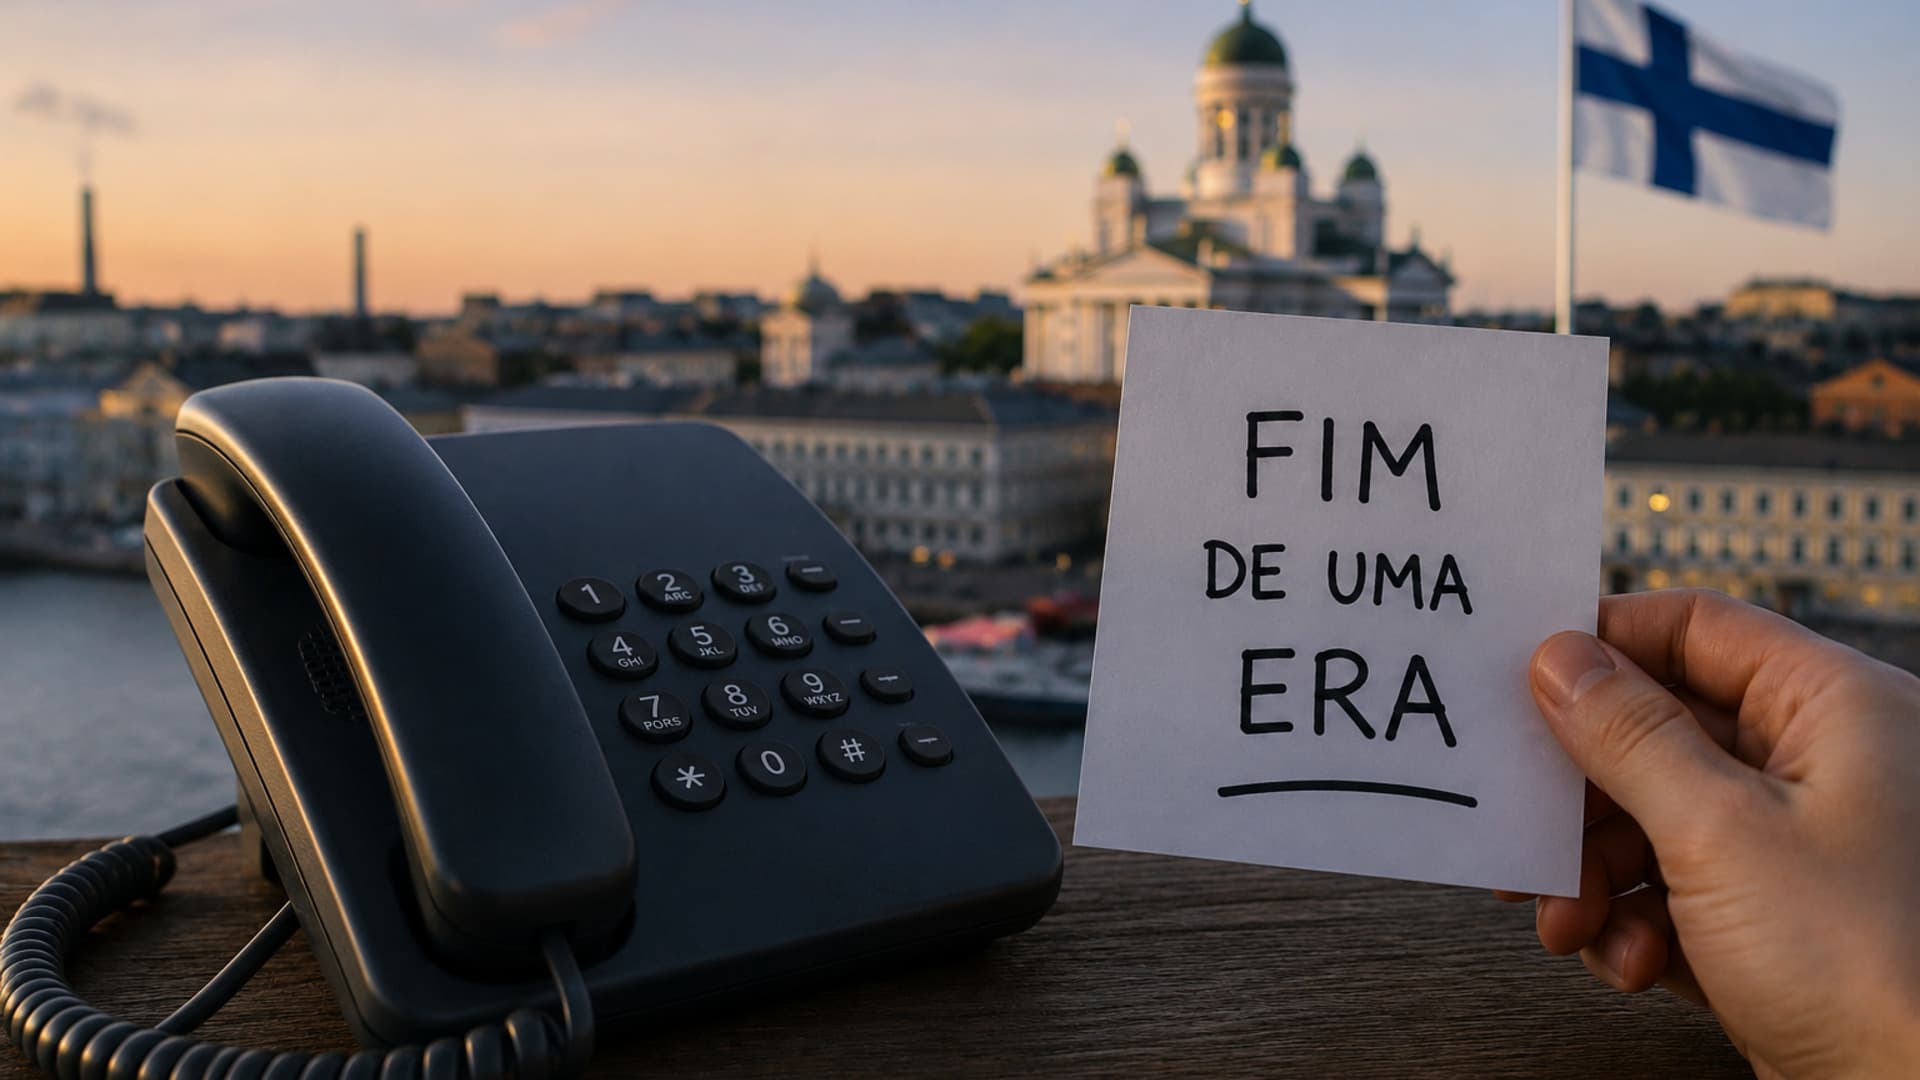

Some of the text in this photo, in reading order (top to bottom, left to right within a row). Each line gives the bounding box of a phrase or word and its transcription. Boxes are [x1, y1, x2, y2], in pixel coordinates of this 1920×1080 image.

[1247, 411, 1442, 511] FIM
[657, 573, 681, 592] 2
[732, 565, 755, 583] 3
[1203, 540, 1472, 614] DE UMA
[581, 583, 601, 605] 1
[690, 626, 713, 646] 5
[768, 616, 789, 636] 6
[612, 636, 633, 656] 4
[700, 647, 724, 656] JKL
[771, 635, 803, 648] MNO
[618, 656, 644, 668] GHI
[802, 672, 824, 694] 9
[724, 684, 748, 705] 8
[804, 692, 843, 705] WXYZ
[1241, 648, 1457, 748] ERA
[639, 695, 660, 718] 7
[840, 738, 865, 763] #
[761, 750, 786, 775] 0
